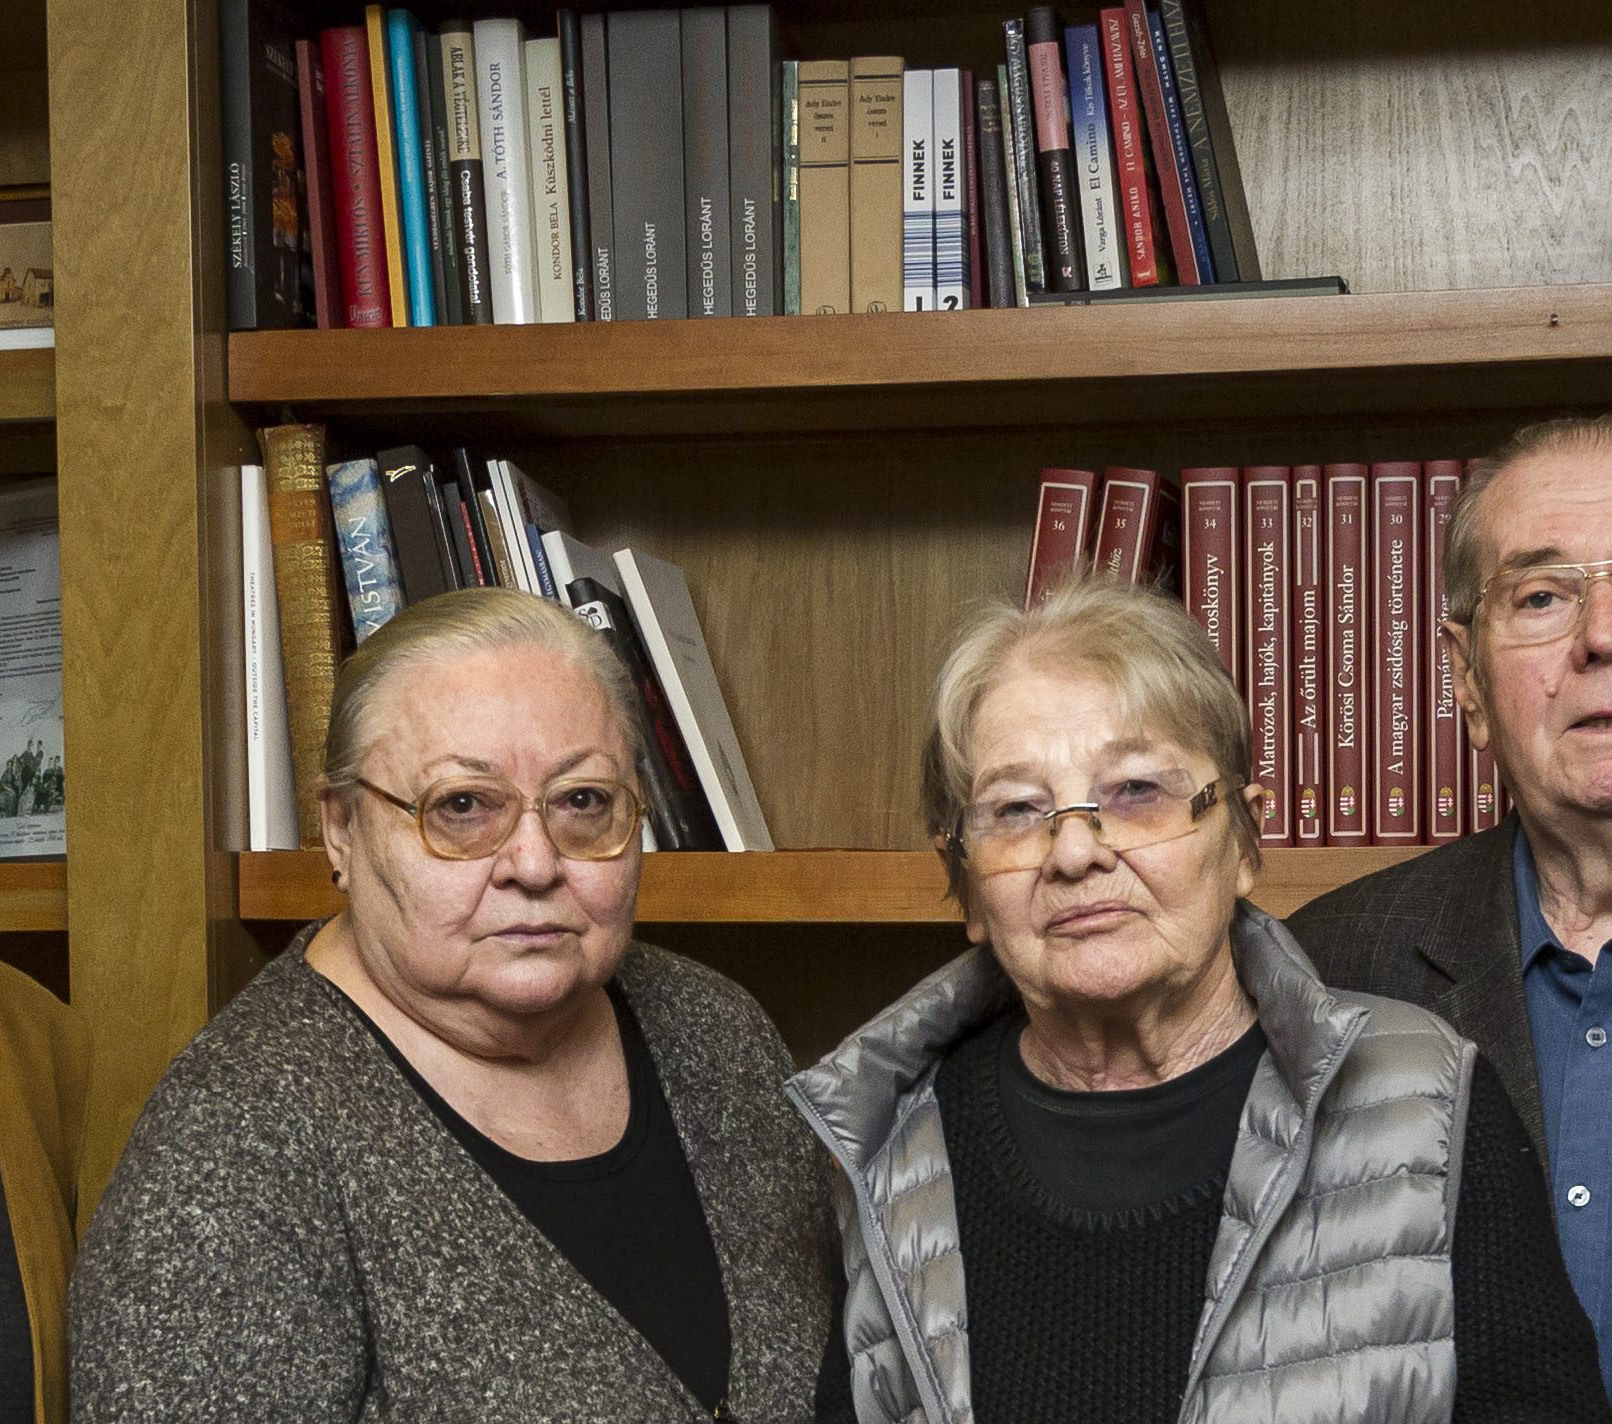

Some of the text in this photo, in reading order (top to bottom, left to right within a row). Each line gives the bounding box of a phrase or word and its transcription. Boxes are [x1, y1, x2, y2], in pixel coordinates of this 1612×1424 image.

[450, 46, 465, 79] ABLAK
[859, 94, 873, 104] Ady
[489, 63, 507, 180] A. TÓTH SÁNDOR
[1085, 123, 1099, 173] Camino
[1193, 135, 1209, 151] A
[913, 139, 925, 201] FINNEK
[942, 138, 955, 201] FINNEK
[1050, 160, 1061, 172] 40
[1087, 176, 1100, 190] El
[459, 169, 474, 206] Csaba
[1052, 174, 1063, 196] NAP
[228, 162, 243, 268] SZÉKELY LÁSZLÓ
[547, 202, 559, 230] BÉLA
[1207, 189, 1221, 220] Siklós
[550, 231, 562, 280] KONDOR
[644, 222, 657, 265] LORÁNT
[699, 197, 714, 315] HEGEDŰS LORÁNT
[743, 198, 757, 316] HEGEDŰS LORÁNT
[1096, 227, 1108, 252] Varga
[597, 247, 611, 289] LORÁNT
[645, 267, 658, 319] HEGEDŰS
[942, 295, 959, 311] 2
[1051, 520, 1065, 531] 36
[1114, 518, 1126, 529] 35
[1203, 518, 1217, 529] 34
[1261, 518, 1273, 529] 33
[1301, 517, 1313, 528] 32
[1340, 514, 1353, 524] 31
[1389, 514, 1403, 525] 30
[348, 516, 384, 611] ISTVÁN
[1337, 564, 1354, 688] Csoma Sándor
[1257, 542, 1281, 778] Matrózok, hajók, kapitányok
[1298, 590, 1323, 729] Az őrült majom
[1386, 539, 1409, 775] A magyar zsidóság története
